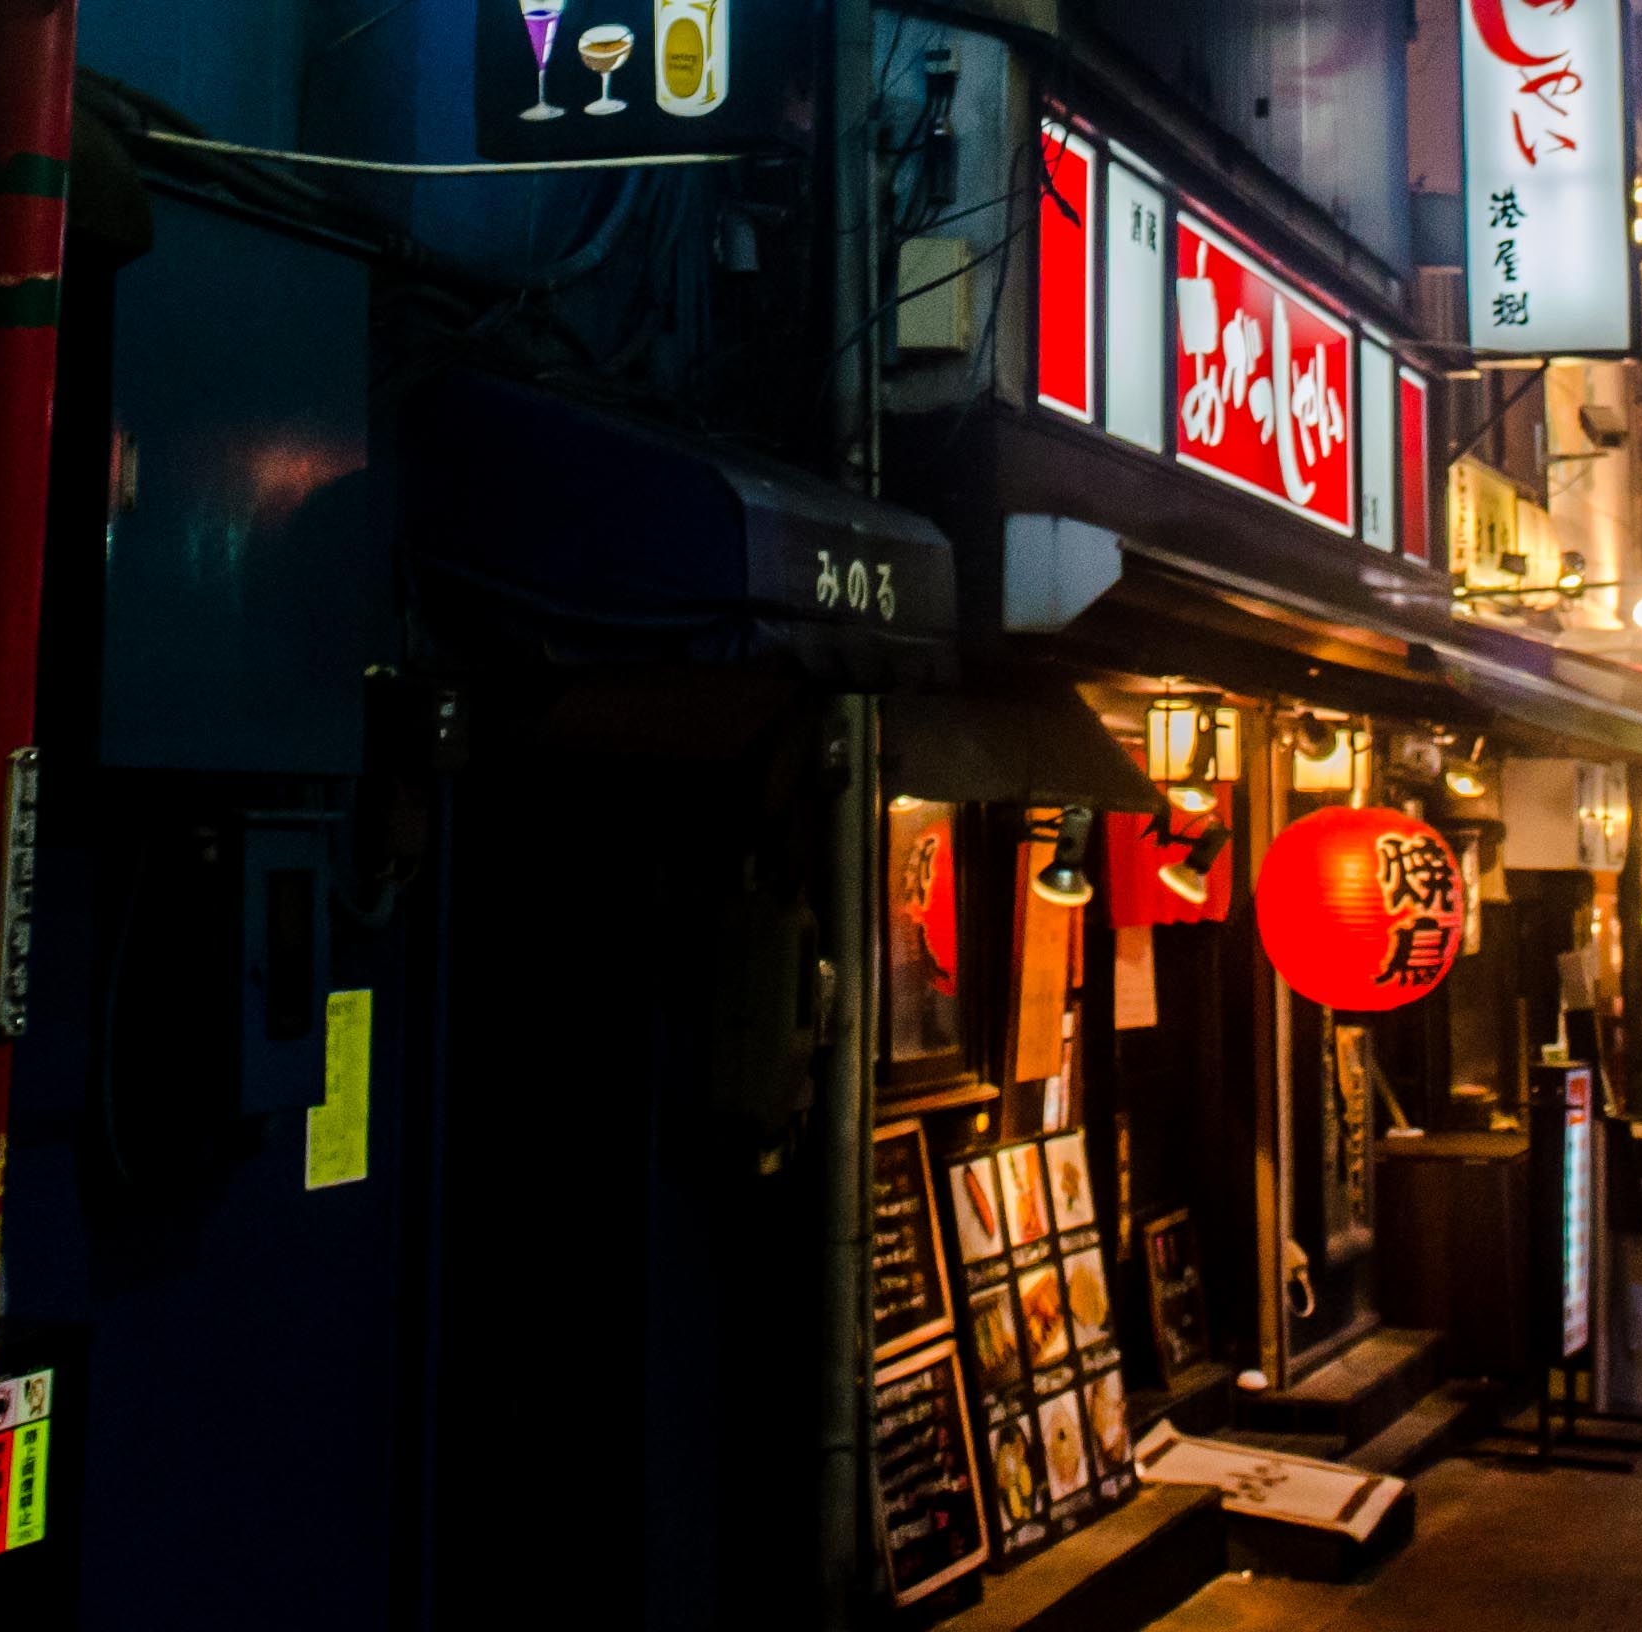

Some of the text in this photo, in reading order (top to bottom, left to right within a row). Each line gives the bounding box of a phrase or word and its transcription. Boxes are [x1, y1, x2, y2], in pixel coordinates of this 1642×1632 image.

[816, 549, 896, 621] みのる
[1375, 834, 1455, 988] 焼鳥
